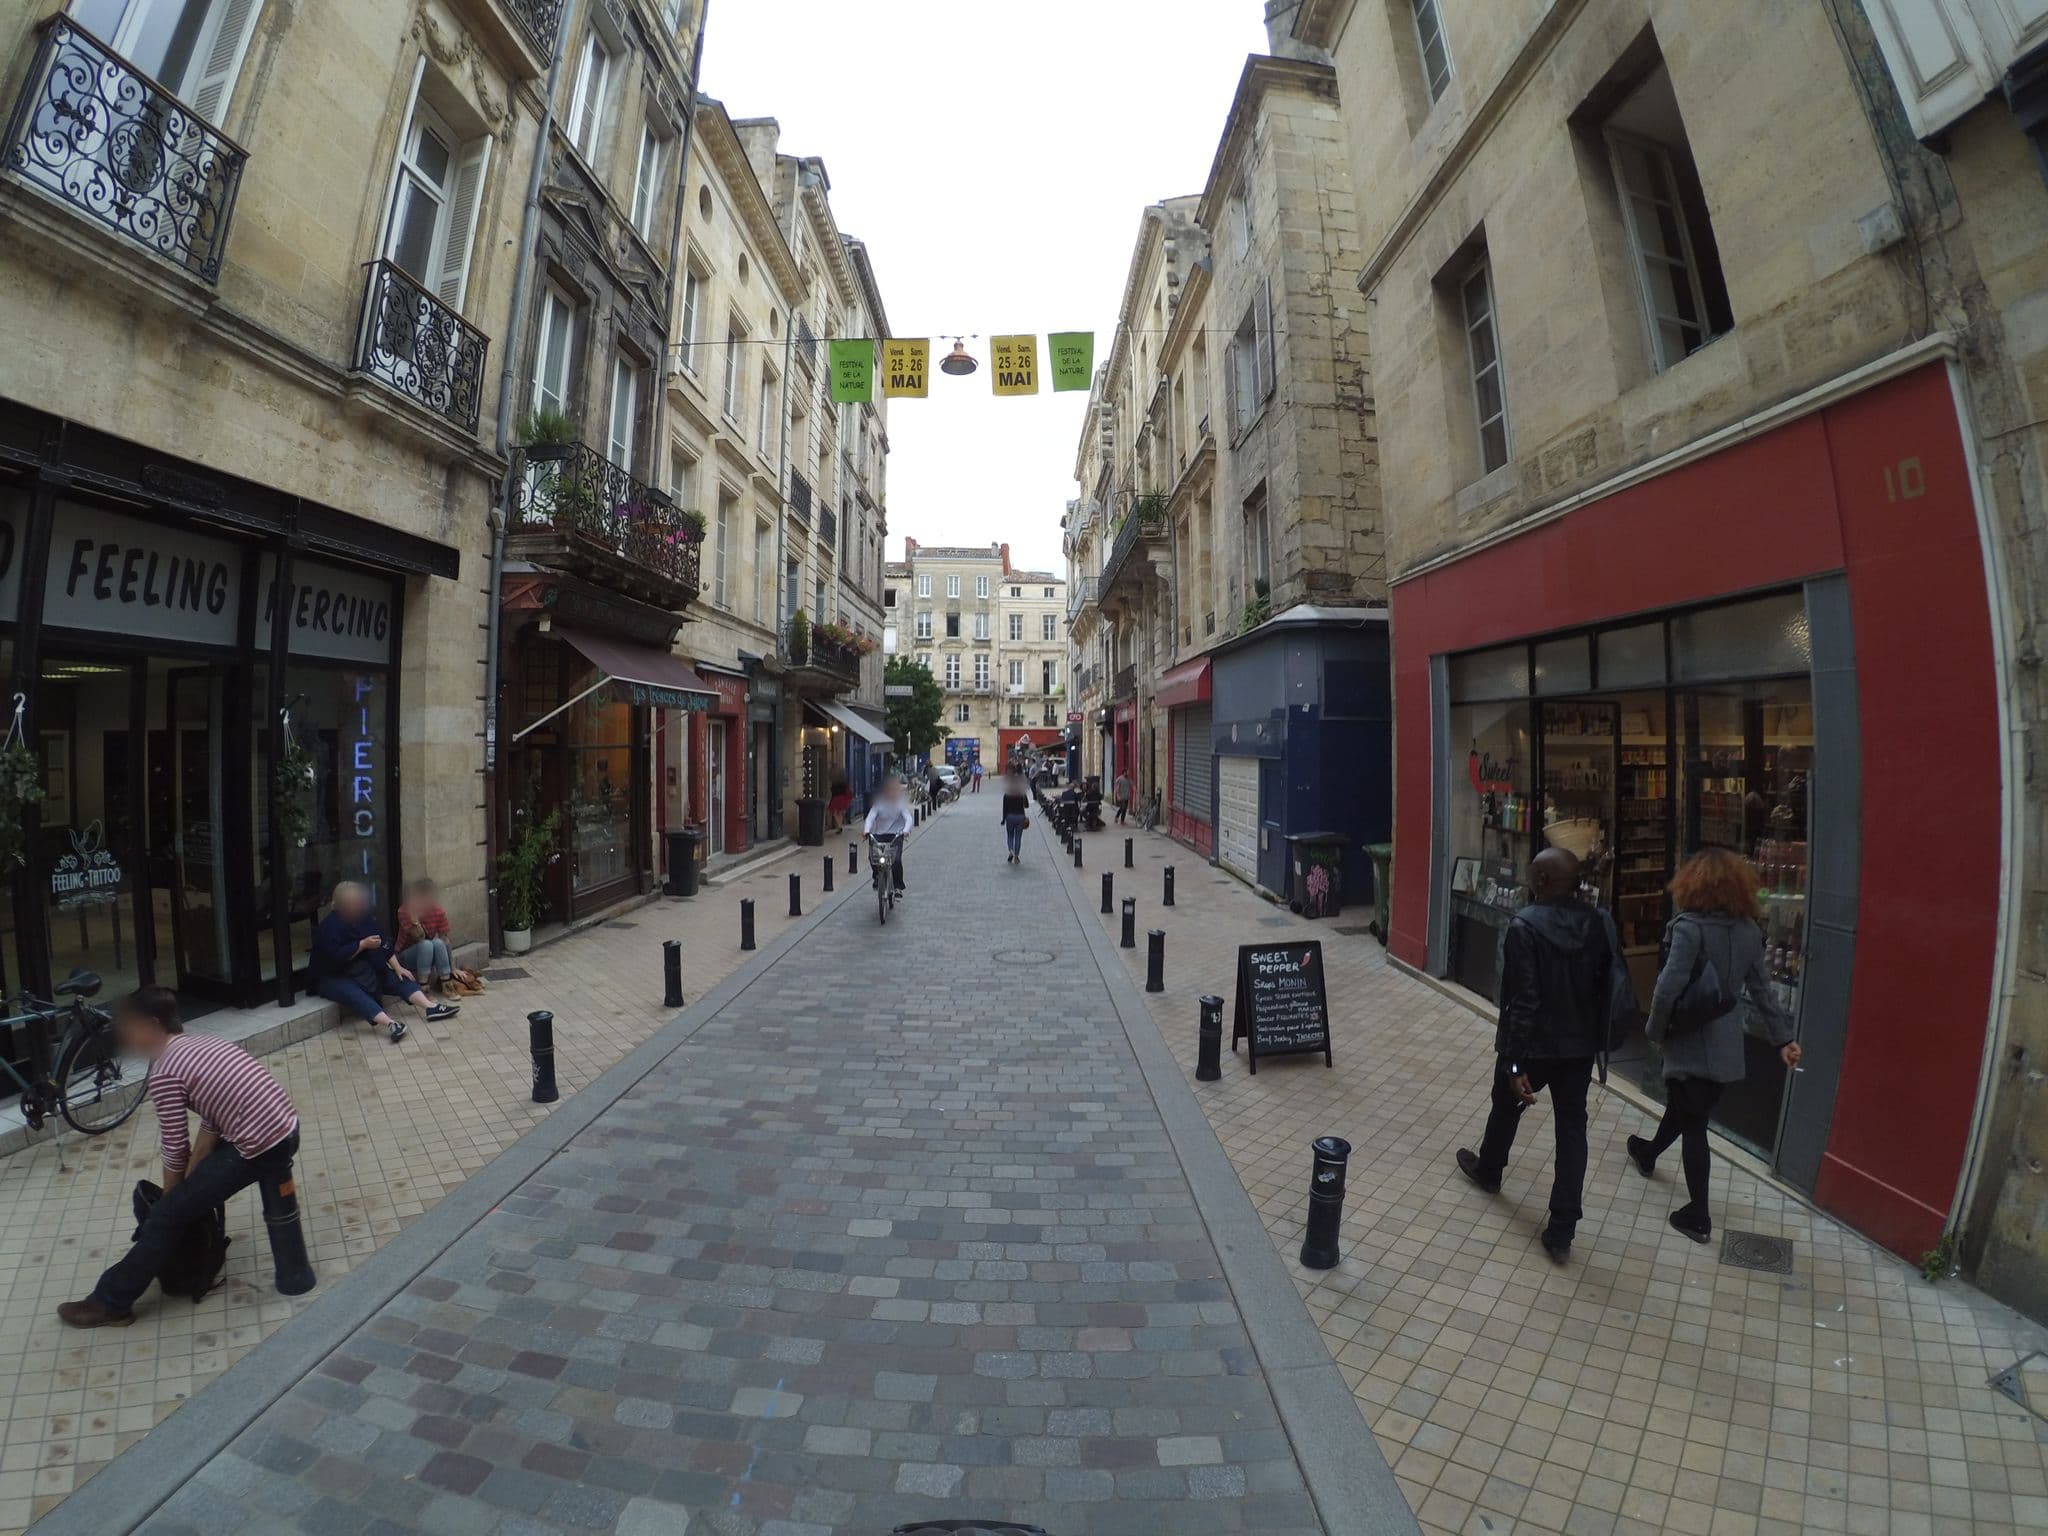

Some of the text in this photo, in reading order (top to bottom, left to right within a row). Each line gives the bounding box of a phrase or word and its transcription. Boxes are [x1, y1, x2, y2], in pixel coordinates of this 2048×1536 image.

[1057, 347, 1084, 356] FESTIVAL
[839, 360, 865, 369] FESTIVAL
[1059, 366, 1085, 376] NATURE
[891, 374, 922, 389] MAI
[998, 370, 1032, 387] MAI
[839, 381, 865, 390] NATURE
[1882, 455, 1926, 504] 10
[66, 539, 229, 616] FEELING
[1479, 752, 1519, 782] Sweet
[52, 867, 121, 894] FEELING TATTOO
[1250, 951, 1289, 964] SWEET
[1259, 962, 1300, 974] PEPPER
[1279, 977, 1307, 989] MONIN
